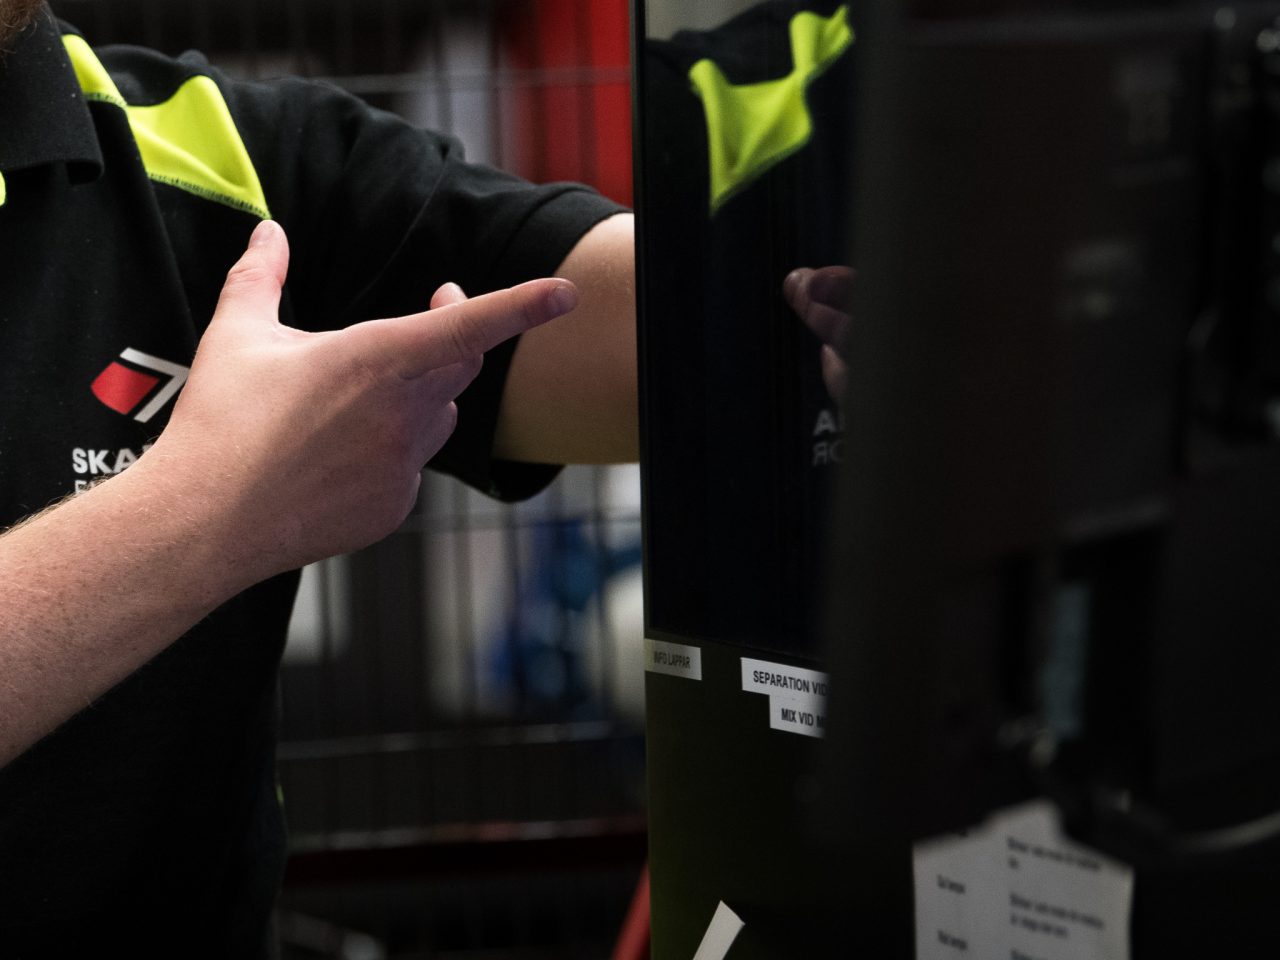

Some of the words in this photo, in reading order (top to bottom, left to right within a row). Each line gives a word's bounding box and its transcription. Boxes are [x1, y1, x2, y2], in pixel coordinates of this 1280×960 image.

[72, 445, 153, 474] SKA
[753, 670, 810, 693] SEPARATION
[781, 707, 797, 723] MIX
[798, 711, 814, 726] VID
